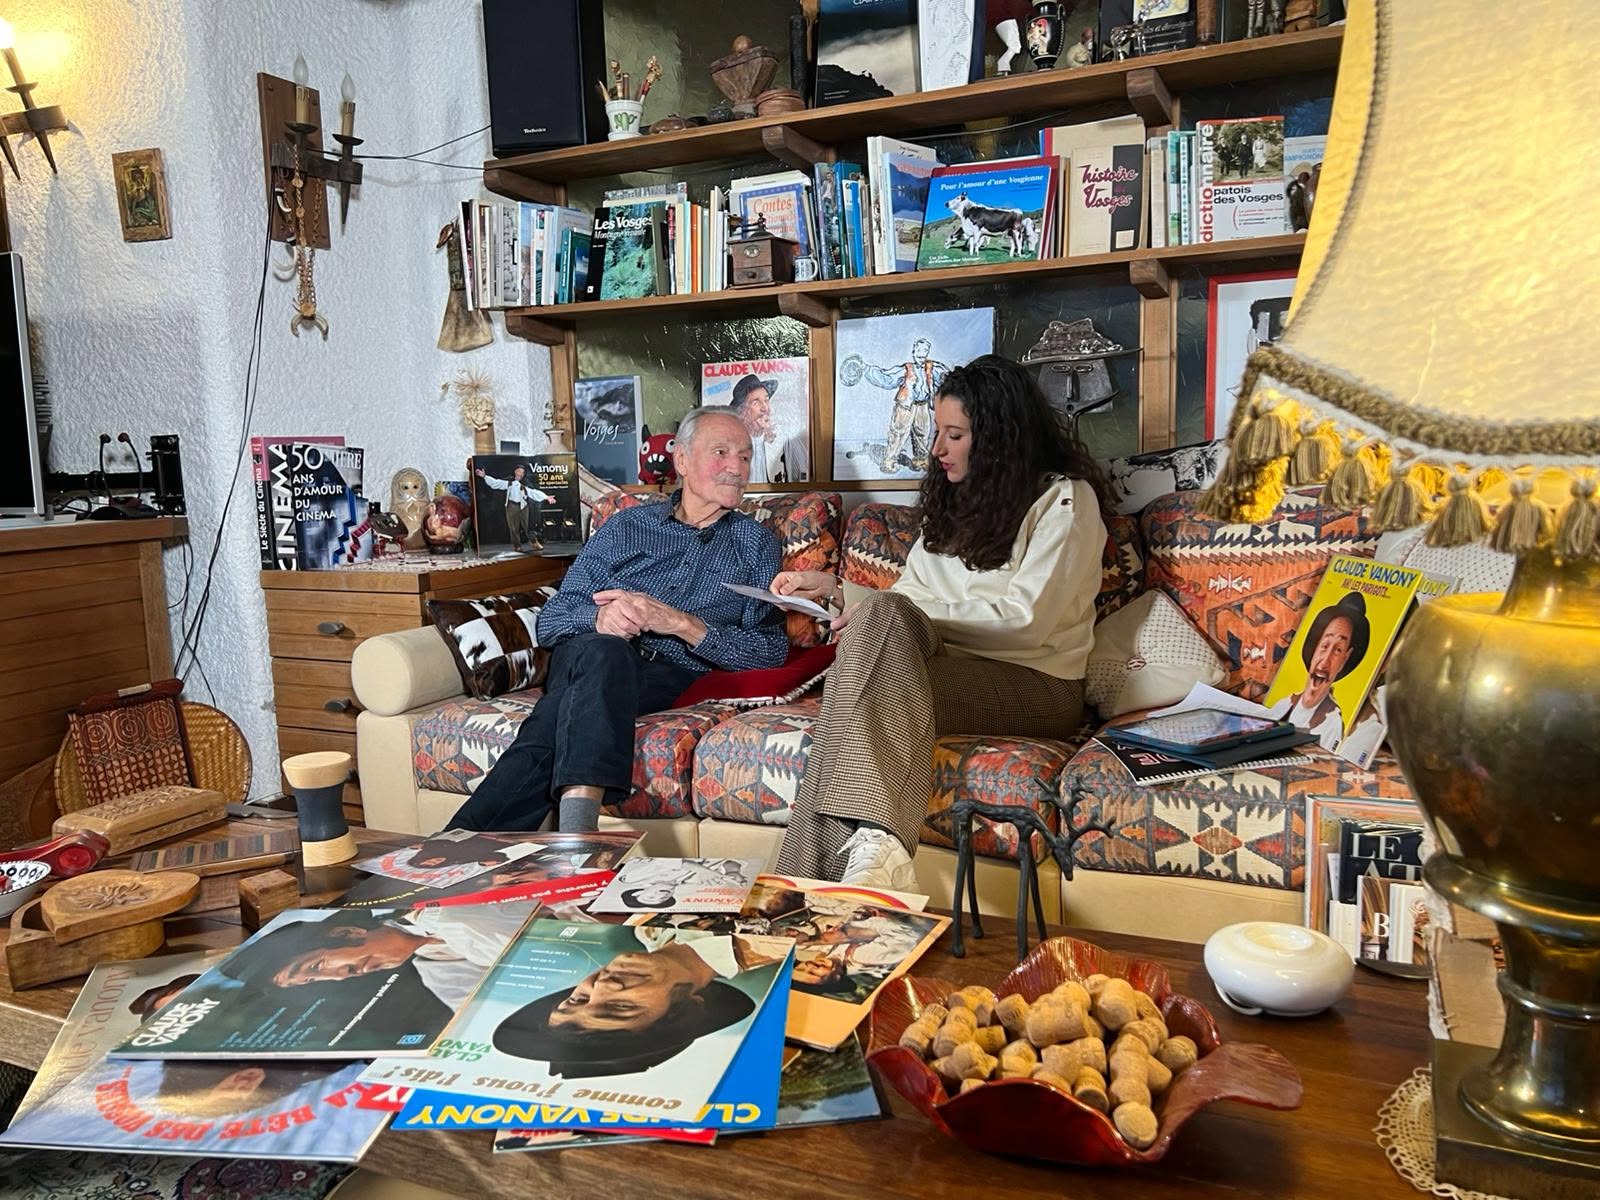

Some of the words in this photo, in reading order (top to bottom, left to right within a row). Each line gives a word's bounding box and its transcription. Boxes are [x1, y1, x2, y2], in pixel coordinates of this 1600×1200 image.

[1285, 152, 1324, 161] AMPIGNON
[941, 183, 957, 191] Pour
[958, 180, 986, 190] l'amour
[987, 178, 1008, 186] d'une
[1009, 175, 1044, 184] Vosgienne
[1077, 164, 1138, 184] histoire
[1200, 124, 1214, 242] dictionnaire
[1083, 184, 1134, 214] Vosges
[1213, 186, 1252, 197] patois
[1213, 195, 1236, 205] des
[1238, 192, 1284, 204] Vosges
[753, 198, 792, 214] Contes
[594, 218, 616, 230] Les
[703, 363, 749, 377] CLAUDE
[583, 418, 619, 445] Vosges
[292, 445, 324, 472] 50
[529, 462, 569, 475] Vanony
[256, 468, 264, 500] Cinéma
[293, 473, 315, 485] ANS
[538, 473, 549, 481] 50
[294, 485, 343, 497] D'AMOUR
[257, 501, 265, 512] du
[268, 445, 298, 571] CINEMA
[295, 498, 310, 510] DU
[259, 514, 268, 538] Siècle
[296, 510, 337, 522] CINEMA
[261, 540, 269, 551] Le
[1333, 559, 1369, 578] CLAUDE
[1370, 565, 1418, 589] VANONY
[1349, 832, 1403, 863] LE
[131, 1002, 197, 1047] CLAUDE
[146, 997, 221, 1048] VANONY
[436, 1039, 492, 1054] VANO
[472, 1075, 563, 1098] j'vous
[572, 1087, 682, 1111] comme
[218, 1103, 316, 1141] BÊTE
[405, 1103, 593, 1125] VANONY
[142, 1120, 216, 1141] DES
